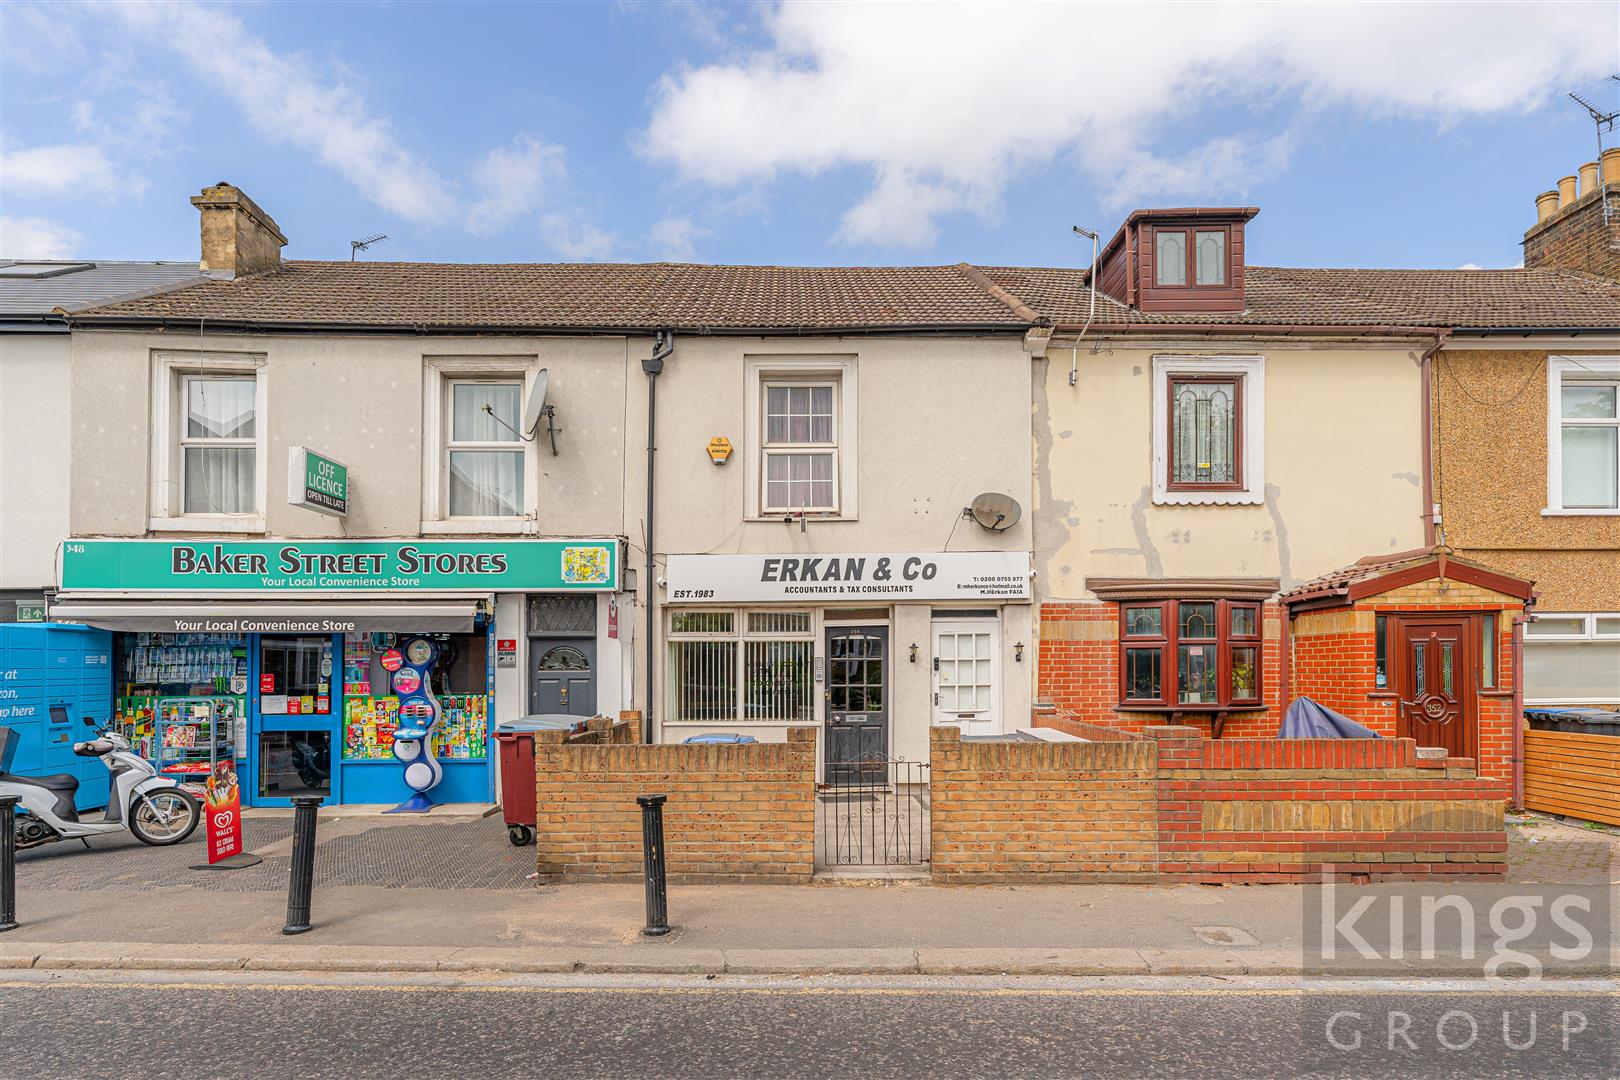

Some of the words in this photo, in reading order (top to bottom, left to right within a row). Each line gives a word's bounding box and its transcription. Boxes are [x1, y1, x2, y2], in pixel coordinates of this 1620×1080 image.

[318, 461, 335, 479] OFF
[308, 471, 343, 497] LICENCE
[307, 489, 322, 502] OPEN
[323, 494, 333, 506] TILL
[333, 498, 345, 509] LATE
[66, 544, 85, 553] 348
[171, 544, 269, 575] BAKER
[279, 545, 388, 575] STREET
[397, 545, 508, 574] STORES
[760, 558, 866, 582] ERKAN
[872, 557, 892, 581] &
[902, 556, 938, 581] Co
[261, 577, 286, 587] Your
[289, 576, 317, 587] Local
[319, 576, 389, 587] Convenience
[390, 576, 420, 586] Store
[673, 590, 714, 598] EST.1983
[784, 586, 837, 594] ACCOUNTANTS
[862, 585, 914, 593] CONSULTANTS
[174, 620, 202, 631] Your
[205, 620, 237, 631] Local
[240, 620, 319, 631] Convenience
[322, 620, 355, 631] Store
[5, 669, 18, 680] at
[11, 705, 35, 717] here
[1426, 704, 1441, 713] 352
